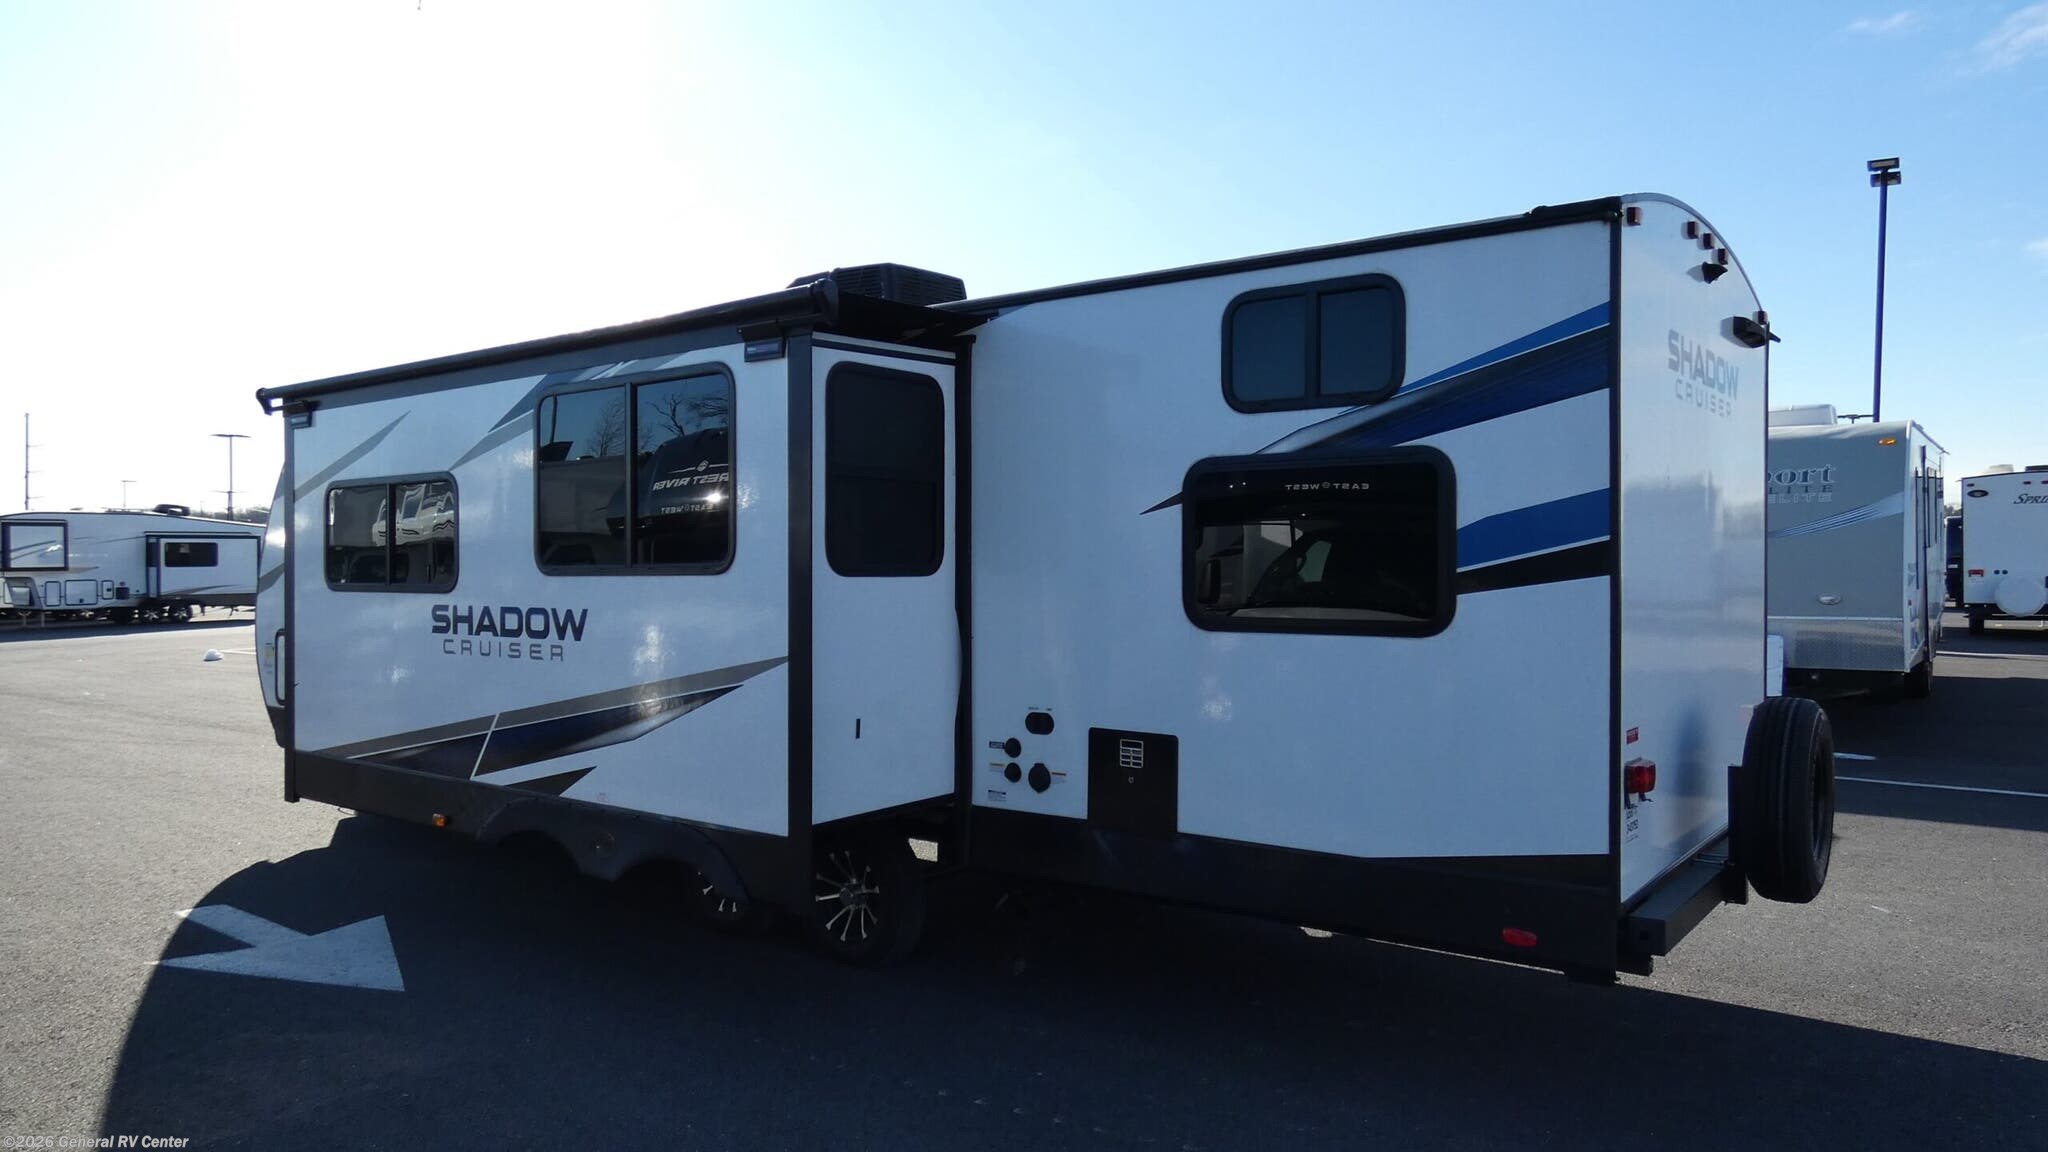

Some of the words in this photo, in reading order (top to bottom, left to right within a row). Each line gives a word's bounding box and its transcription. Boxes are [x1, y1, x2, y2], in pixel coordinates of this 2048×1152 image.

[1668, 329, 1739, 401] SHADOW
[1676, 378, 1732, 419] CRUISER
[431, 604, 588, 642] SHADOW
[442, 638, 564, 662] CRUISER
